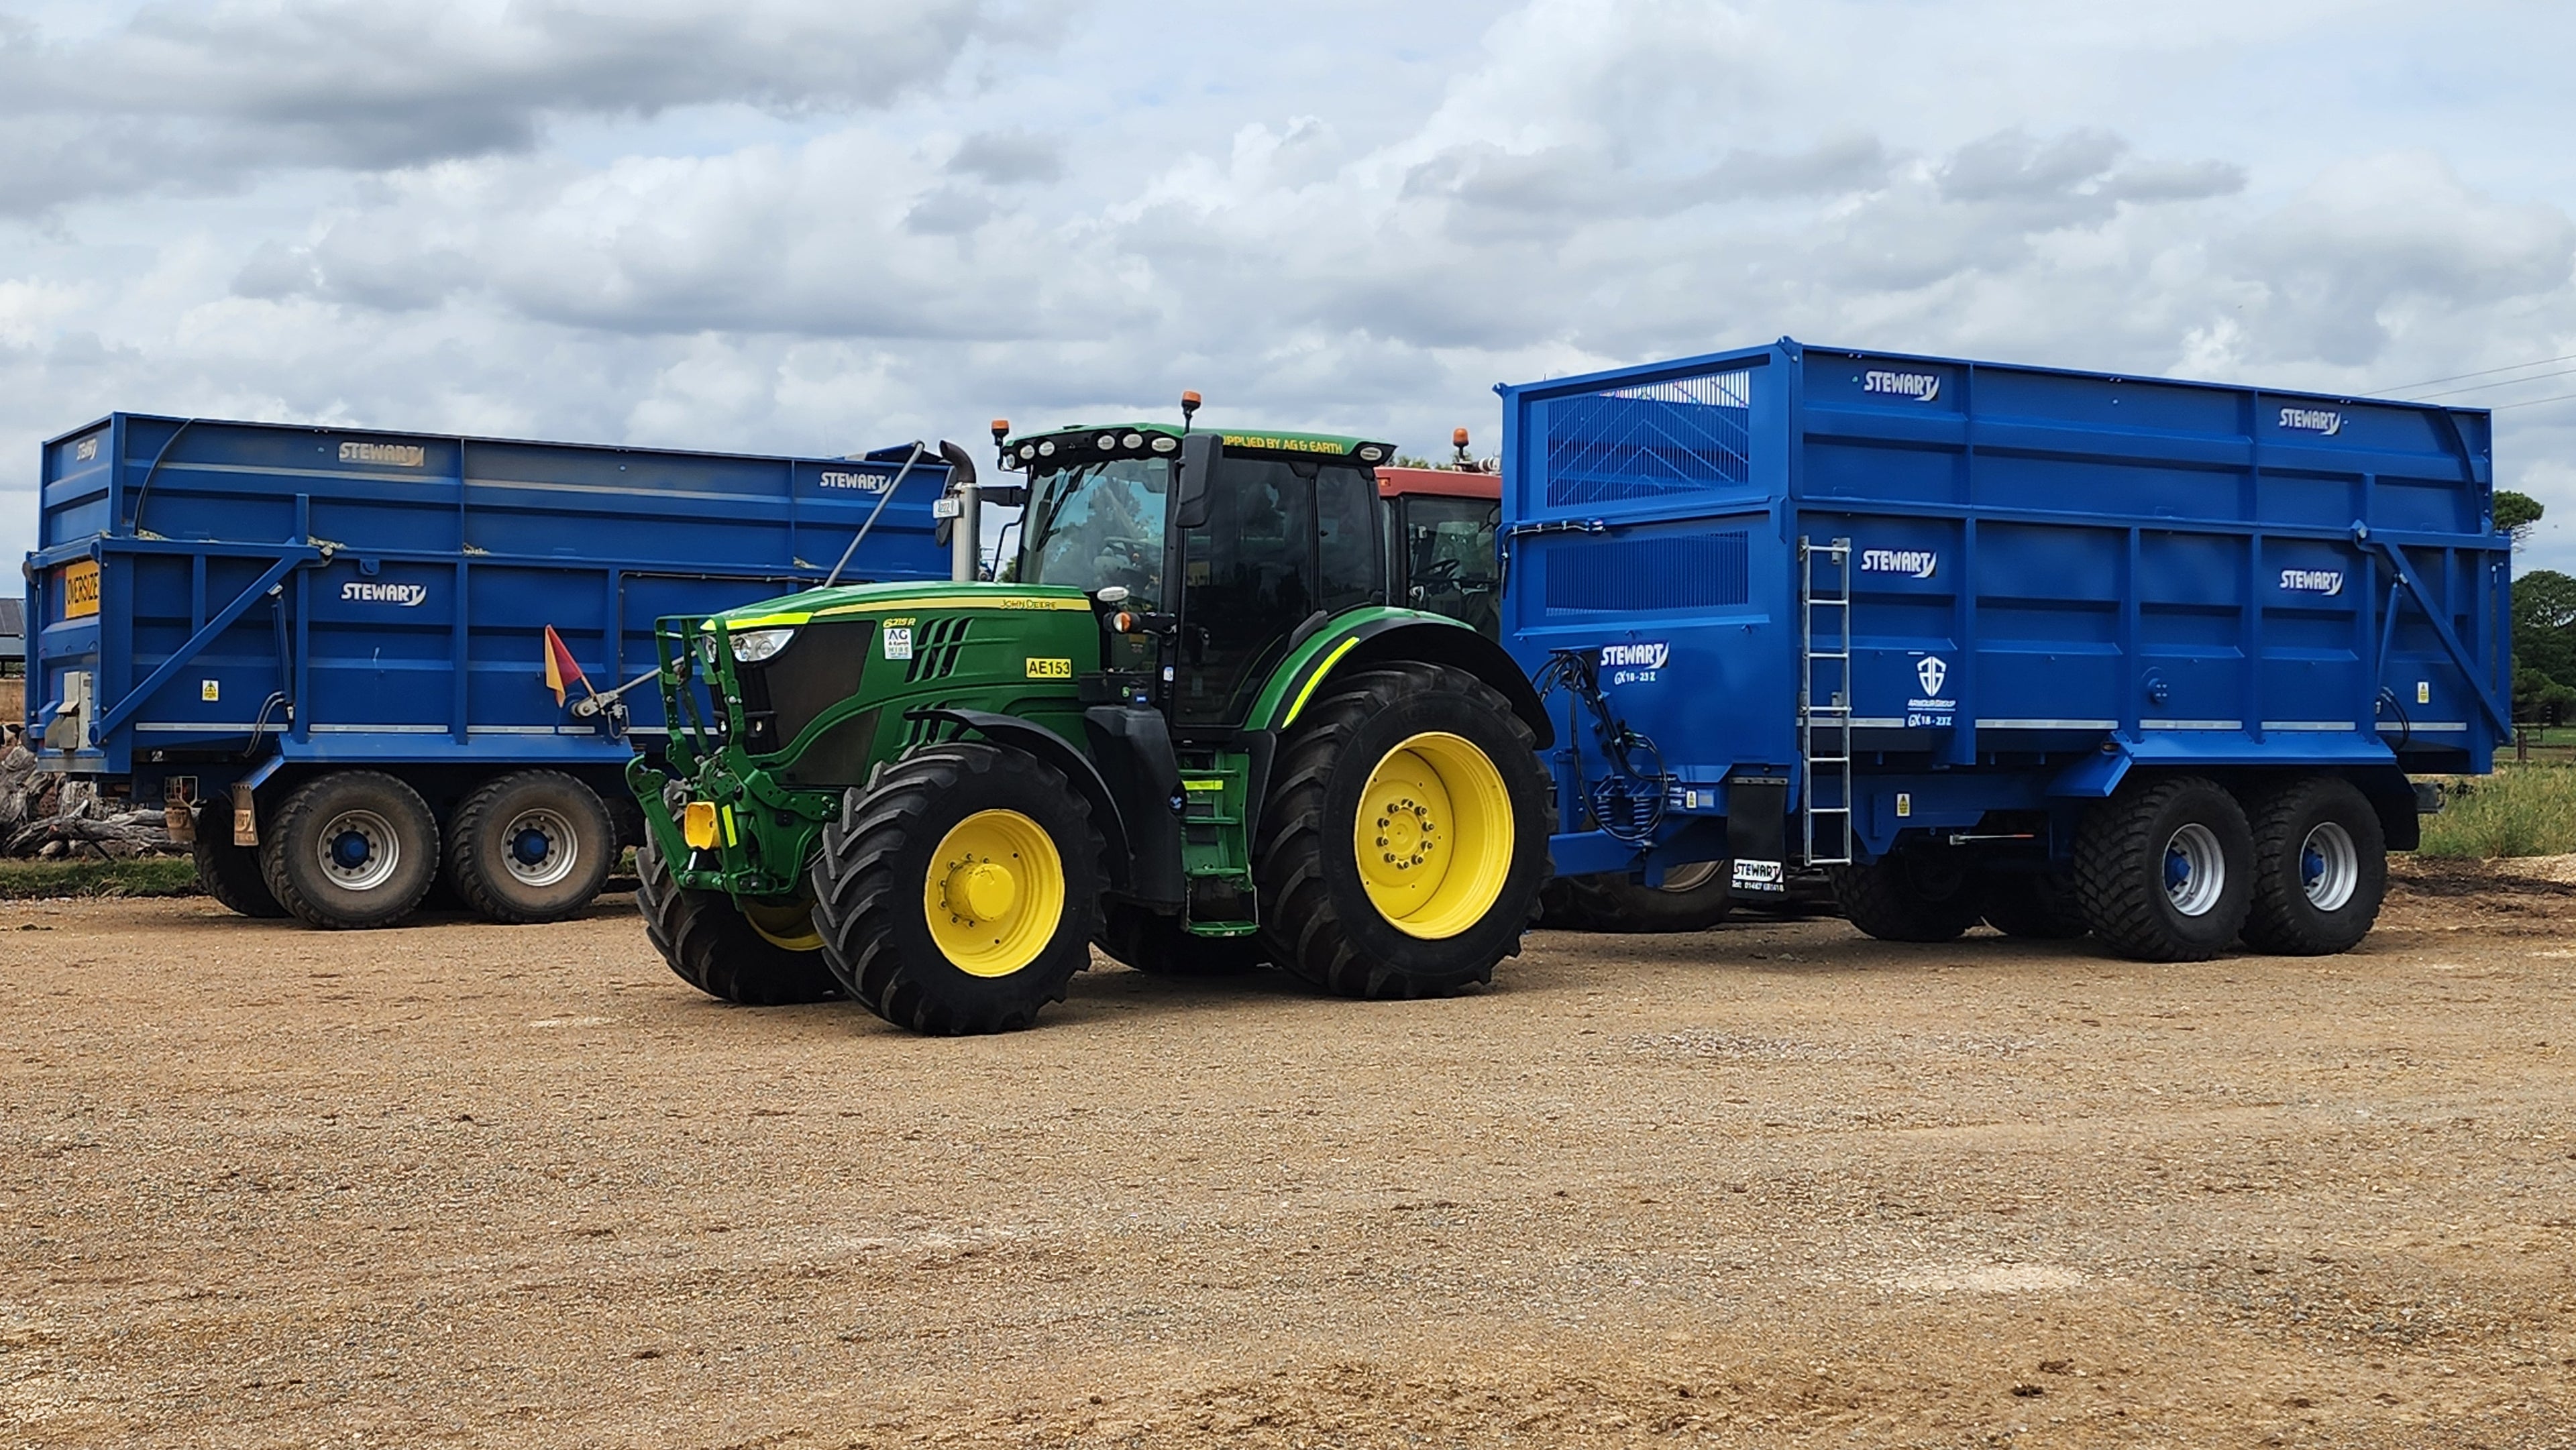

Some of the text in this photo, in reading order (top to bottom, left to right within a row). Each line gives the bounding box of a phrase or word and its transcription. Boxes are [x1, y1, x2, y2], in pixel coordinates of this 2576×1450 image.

[1864, 370, 1940, 401] STEWART
[2279, 408, 2341, 435] STEWART
[339, 441, 424, 466] STEWART
[1222, 435, 1344, 455] UPPLIED BY AG & EARTH
[819, 471, 892, 494] STEWART
[1861, 550, 1937, 578] STEWART
[341, 582, 427, 606] STEWART
[2279, 569, 2344, 596] STEWART
[889, 629, 908, 640] AG
[1600, 642, 1670, 669] STEWART
[1028, 661, 1070, 675] AE153
[1733, 862, 1782, 883] STEWART
